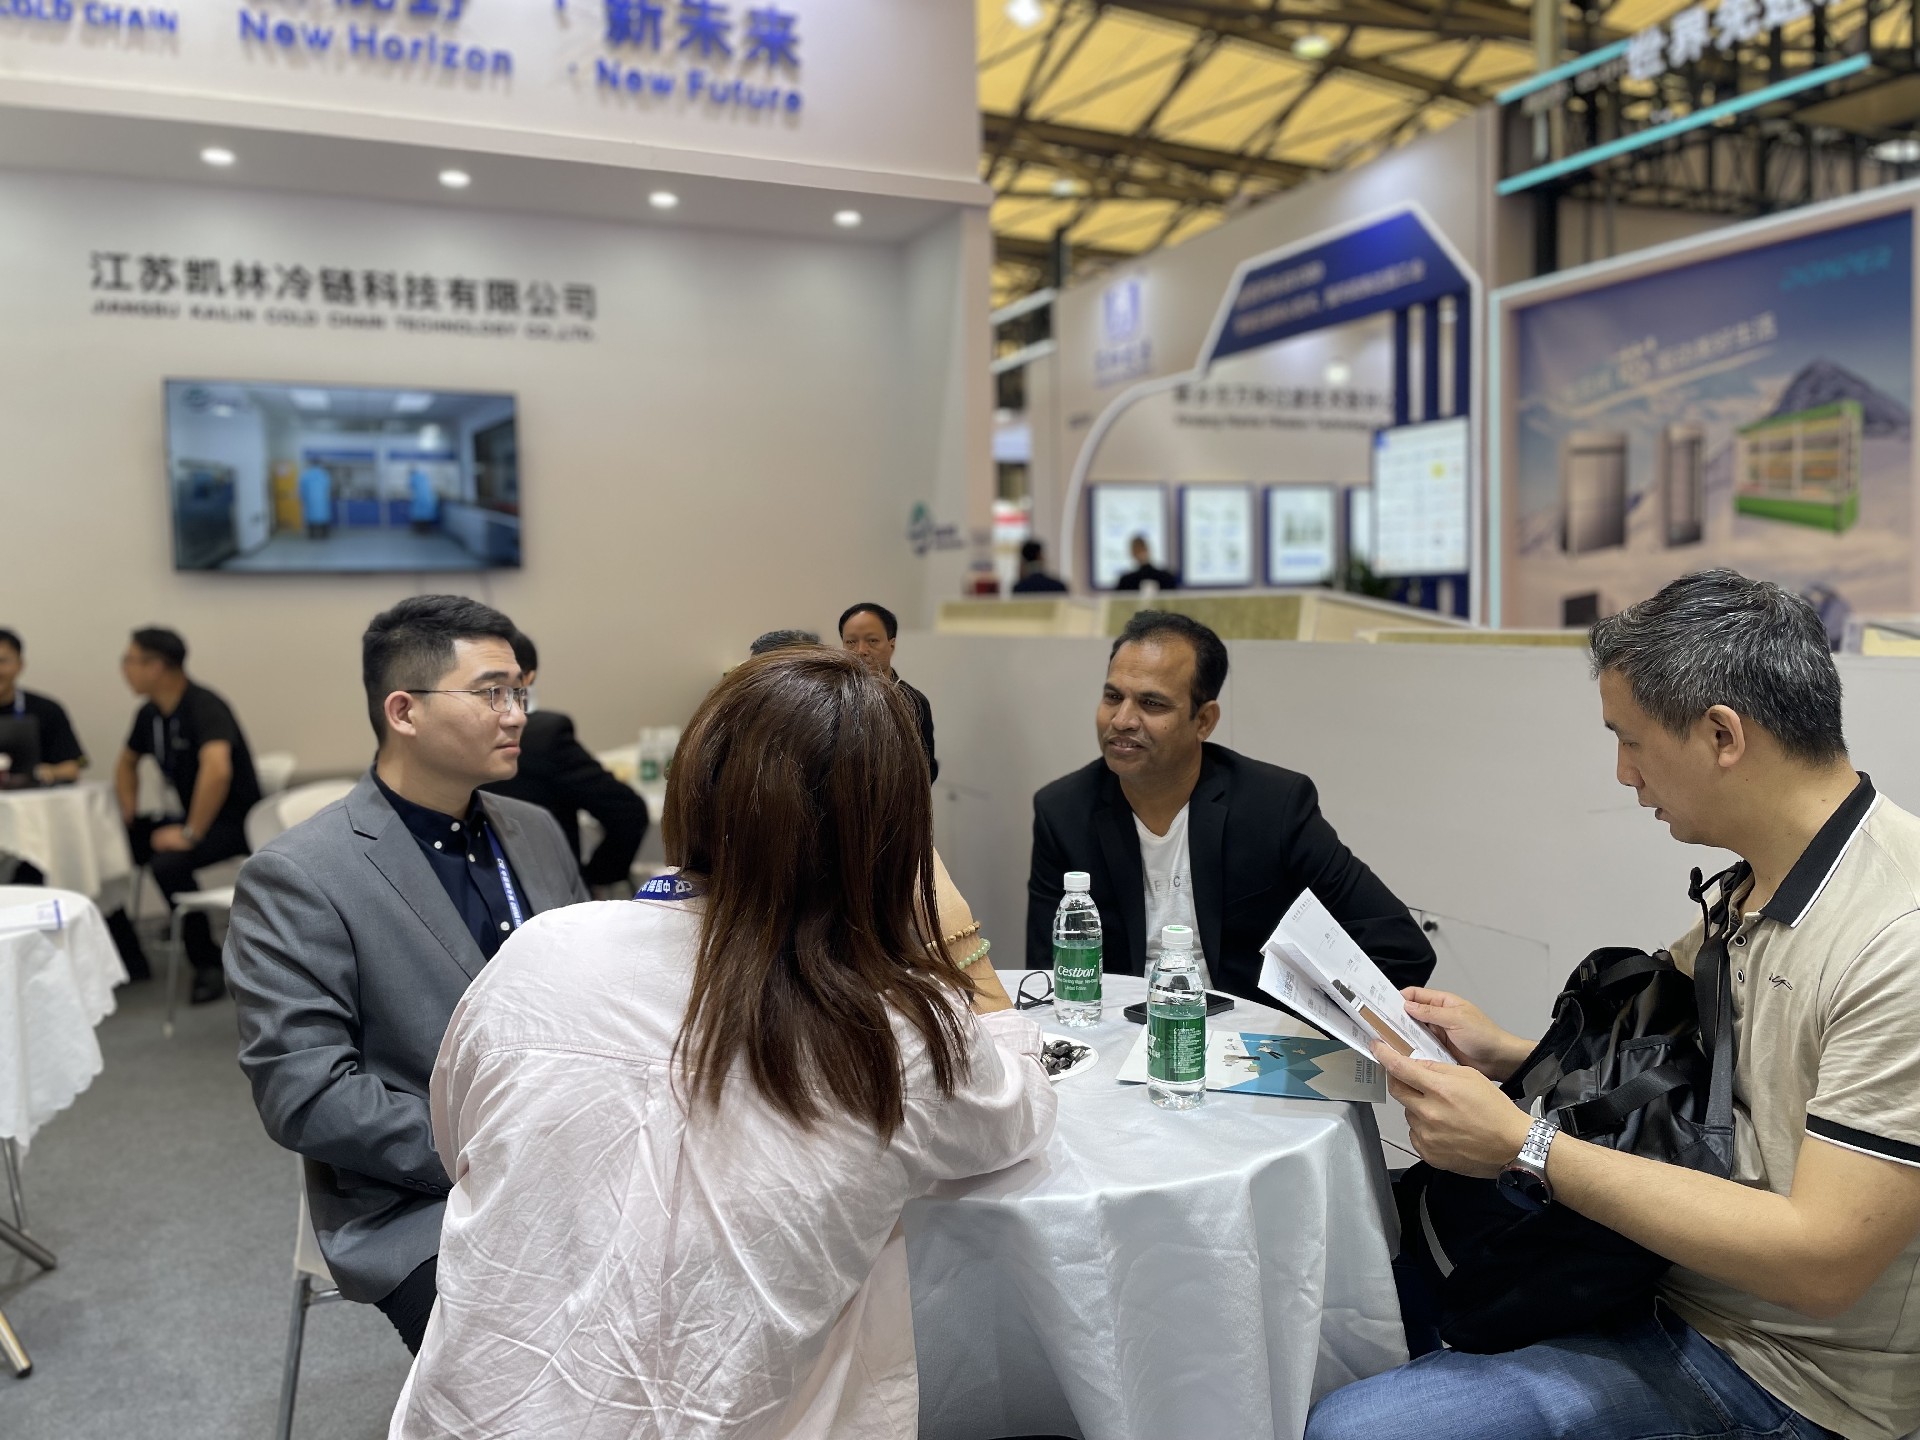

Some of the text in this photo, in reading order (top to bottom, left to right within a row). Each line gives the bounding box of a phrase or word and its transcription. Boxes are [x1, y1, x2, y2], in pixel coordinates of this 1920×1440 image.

[84, 2, 179, 32] CHAIN
[238, 8, 334, 50] New
[348, 22, 513, 77] Horizon
[596, 58, 801, 112] New Future
